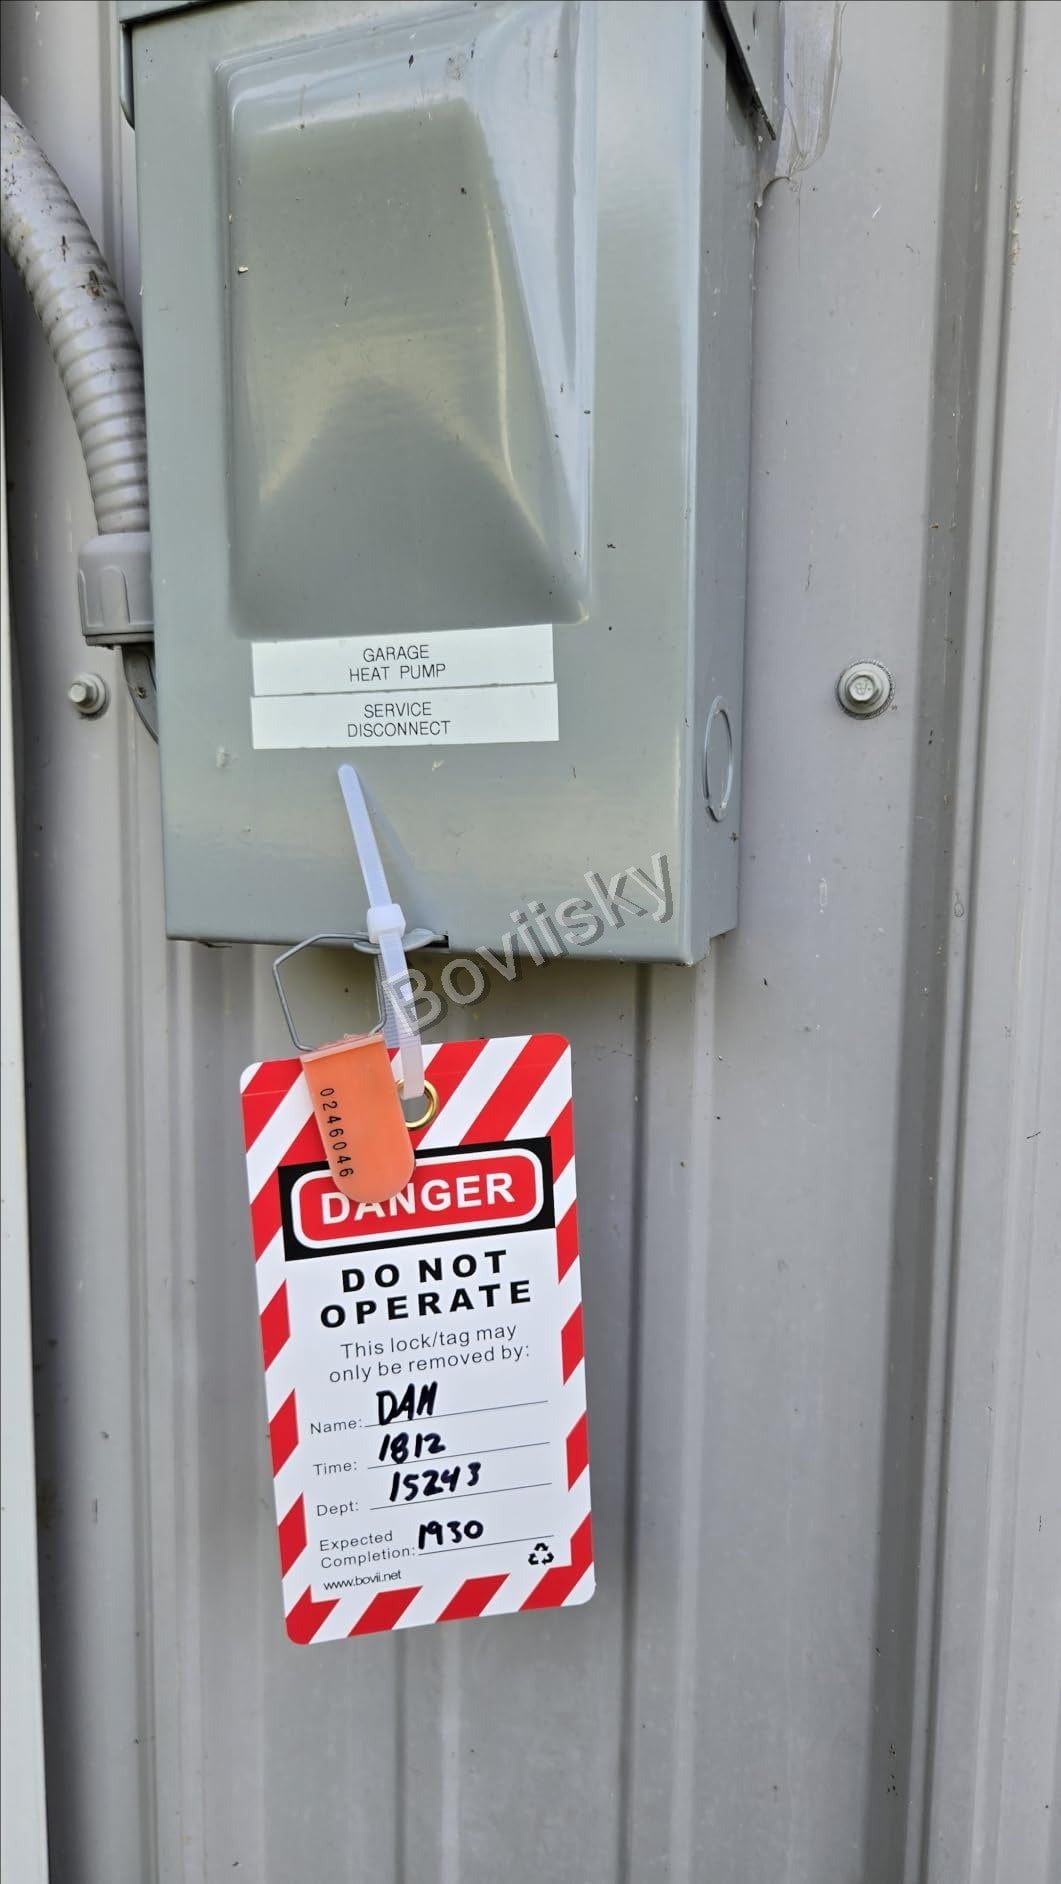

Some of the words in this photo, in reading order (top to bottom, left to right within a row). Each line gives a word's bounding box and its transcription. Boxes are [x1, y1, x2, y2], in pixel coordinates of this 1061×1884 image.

[363, 644, 430, 663] GARAGE
[350, 666, 389, 682] HEAT
[400, 663, 446, 680] PUMP
[364, 702, 432, 718] SERVICE
[348, 720, 450, 738] DISCONNECT
[320, 1088, 354, 1177] 0246046
[342, 1263, 400, 1293] DO
[419, 1250, 507, 1283] NOT
[320, 1280, 531, 1328] OPERATE
[340, 1341, 384, 1359] This
[391, 1331, 470, 1353] lock/tag
[477, 1325, 517, 1341] may
[329, 1365, 372, 1383] only
[378, 1362, 402, 1377] be
[409, 1346, 495, 1373] removed
[502, 1344, 530, 1362] by:
[310, 1419, 363, 1435] Name:
[379, 1432, 446, 1464] 1812
[313, 1461, 358, 1476] Time:
[389, 1462, 481, 1502] 15243
[317, 1501, 359, 1517] Dept:
[319, 1530, 393, 1551] Expected
[418, 1520, 484, 1550] 1930
[321, 1546, 416, 1569] Completion:
[323, 1570, 402, 1590] www.bovii.net
